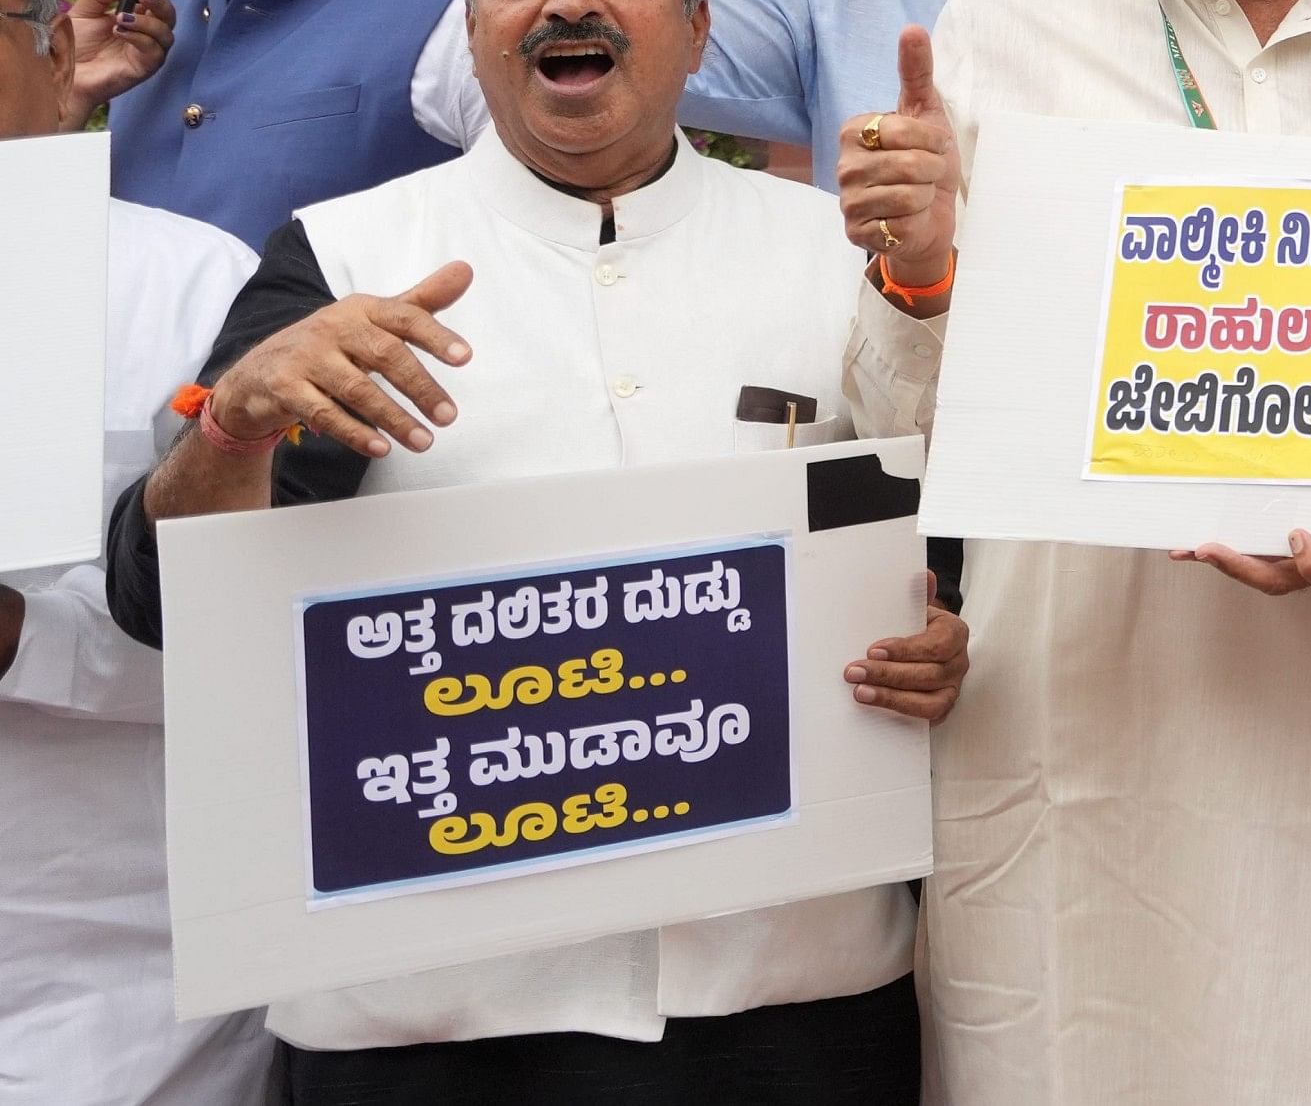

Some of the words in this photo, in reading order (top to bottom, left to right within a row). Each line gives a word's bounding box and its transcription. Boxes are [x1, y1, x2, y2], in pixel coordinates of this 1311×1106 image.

[1120, 206, 1267, 289] ವಾಲ್ಮೀಕಿ
[346, 597, 442, 676] ಅತ್ತ
[451, 576, 609, 647] ದಲಿತರ
[623, 559, 751, 632] ದುಡ್ಡು
[423, 647, 688, 718] ಲೂಟಿ...
[356, 737, 458, 819] ಇತ್ತ
[469, 698, 751, 787] ಮುಡಾವೂ
[427, 782, 691, 856] ಲೂಟಿ...
